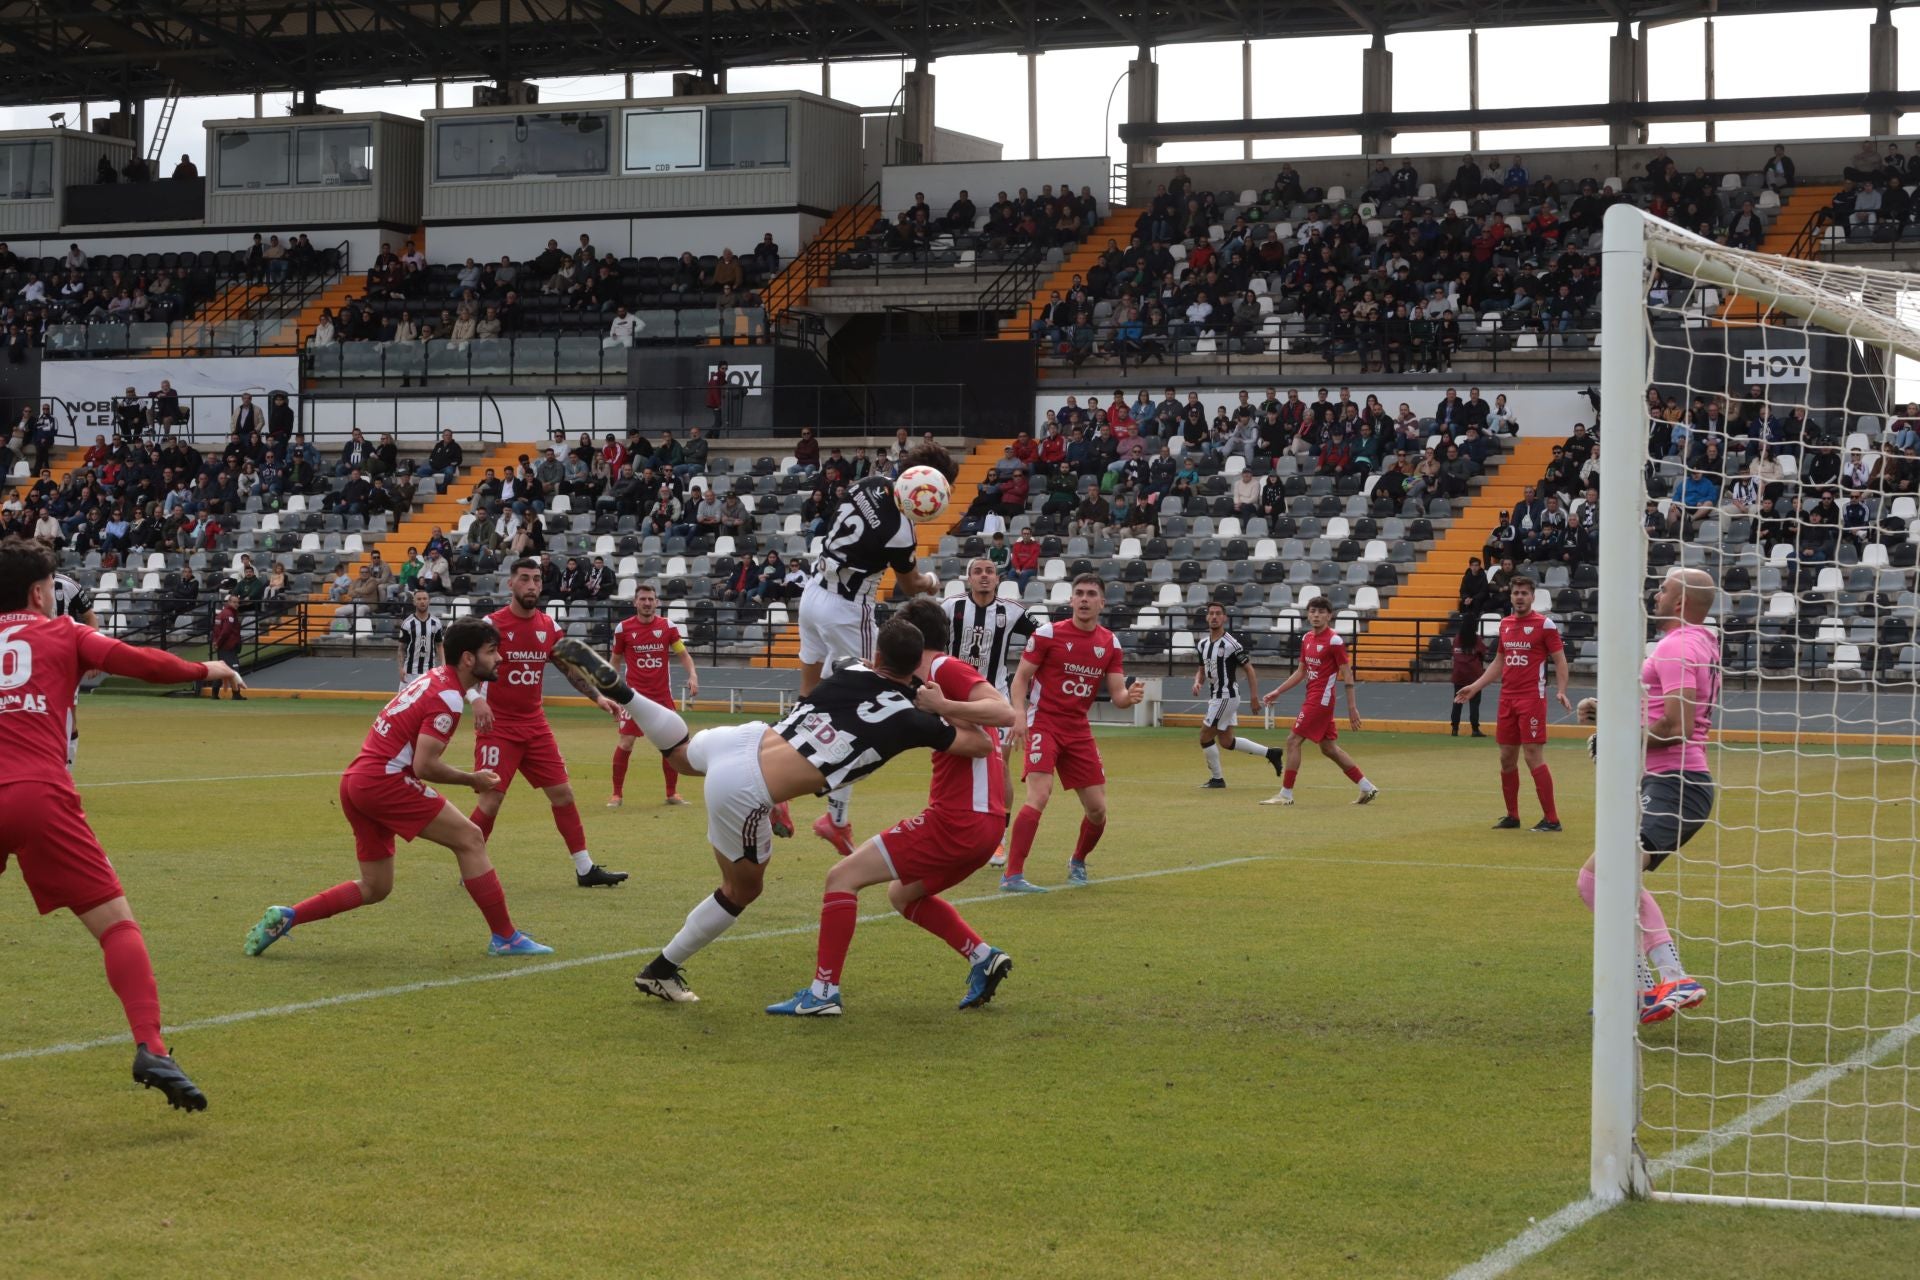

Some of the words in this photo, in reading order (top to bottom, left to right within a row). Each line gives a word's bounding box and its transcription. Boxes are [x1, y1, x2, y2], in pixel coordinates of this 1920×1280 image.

[1746, 356, 1806, 377] HOY
[825, 503, 865, 551] 12
[0, 624, 33, 690] 6
[506, 651, 548, 660] TOMALIA
[633, 643, 665, 651] TOMALIA
[1063, 662, 1103, 676] TOMALIA
[856, 690, 915, 723] 9
[1031, 733, 1042, 750] 2
[481, 745, 500, 767] 18
